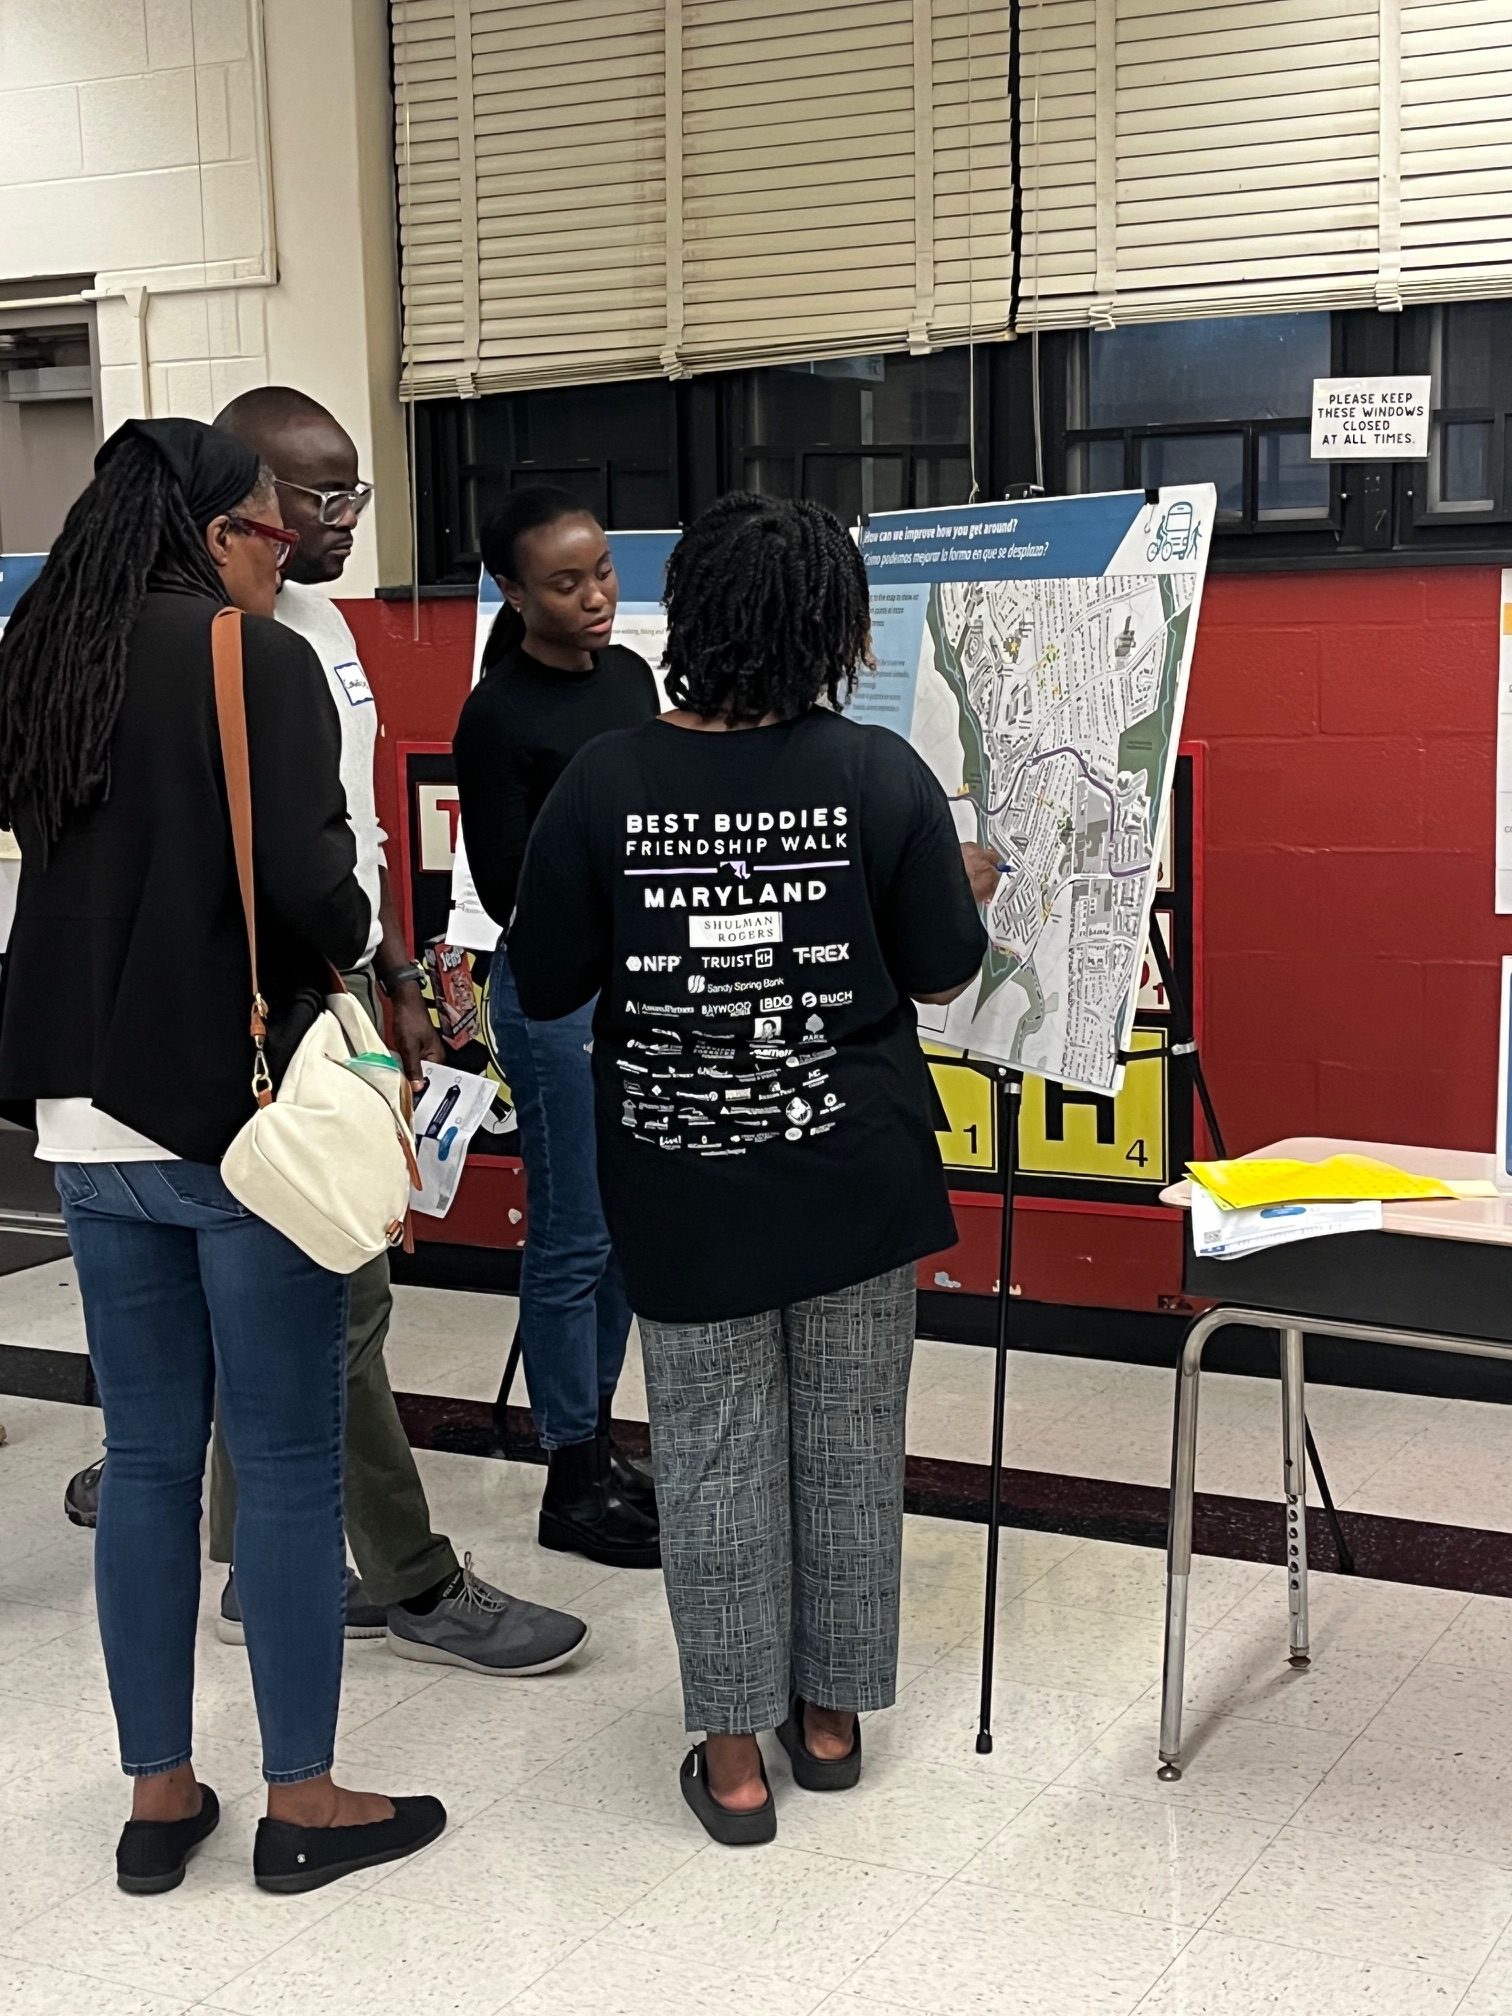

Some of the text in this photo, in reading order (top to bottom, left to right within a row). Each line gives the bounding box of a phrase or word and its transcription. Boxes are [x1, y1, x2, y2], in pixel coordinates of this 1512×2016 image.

[1329, 392, 1413, 405] PLEASE KEEP
[1317, 405, 1424, 419] THESE WINDOWS
[1342, 420, 1390, 431] CLOSED
[1322, 434, 1338, 445] AT
[1344, 434, 1367, 444] ALL
[863, 518, 1018, 544] How can we improve how you get around?
[880, 551, 912, 568] podemos
[912, 549, 940, 567] mejorar
[940, 547, 948, 562] la
[949, 547, 971, 562] forma
[972, 549, 982, 560] en
[983, 548, 997, 563] que
[998, 547, 1006, 559] se
[1007, 541, 1049, 561] desplaza?
[626, 806, 848, 833] BEST BUDDIES
[626, 833, 847, 856] FRIENDSHIP WALK
[644, 880, 827, 908] MARYLAND
[704, 916, 774, 931] SHULMAN
[718, 928, 775, 943] ROGERS
[644, 955, 680, 972] NFP
[702, 953, 753, 968] TRUIST
[707, 977, 784, 993] Sandy Spring Bank
[820, 991, 853, 1004] BUCH
[1153, 983, 1164, 1004] 1
[701, 1001, 752, 1016] BAYWOOD
[963, 1124, 1149, 1168] 1 4
